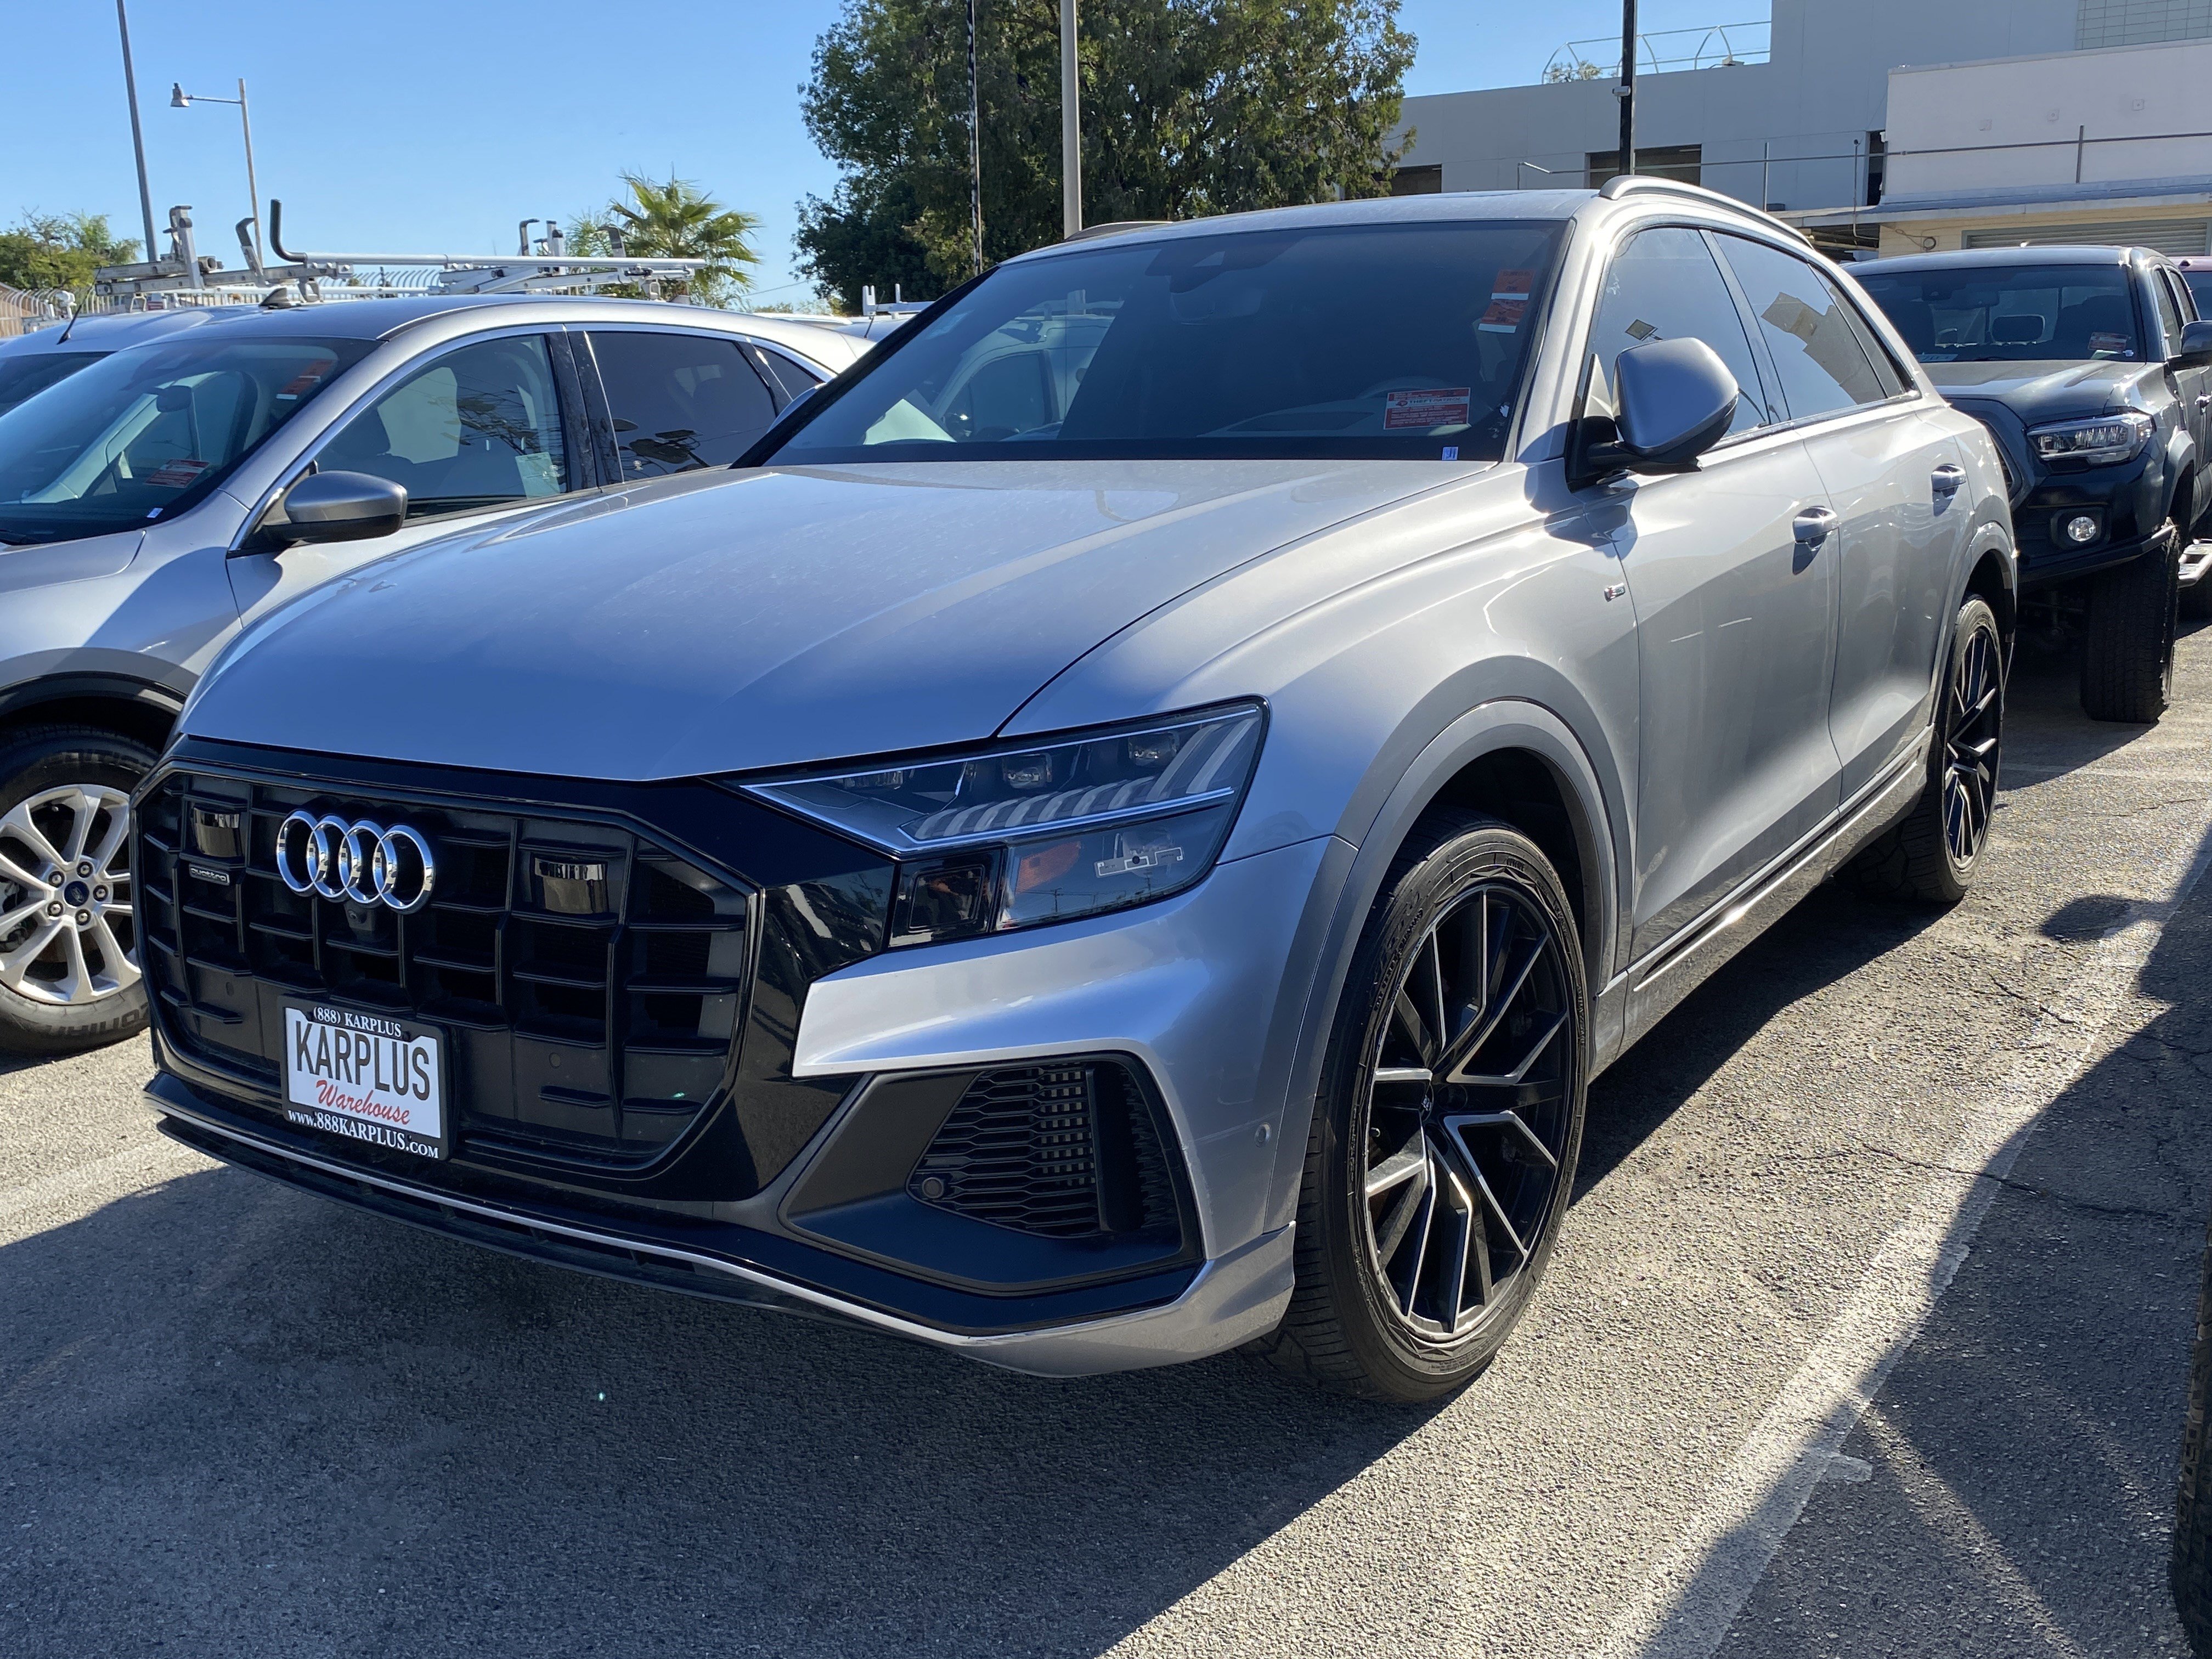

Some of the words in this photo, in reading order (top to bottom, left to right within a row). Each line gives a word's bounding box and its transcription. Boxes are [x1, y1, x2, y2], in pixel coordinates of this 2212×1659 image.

[190, 868, 227, 881] quattro
[313, 1006, 341, 1024] (888)
[345, 1012, 402, 1037] KARPLUS
[296, 1020, 430, 1101] KARPLUS
[316, 1080, 410, 1125] Warehouse
